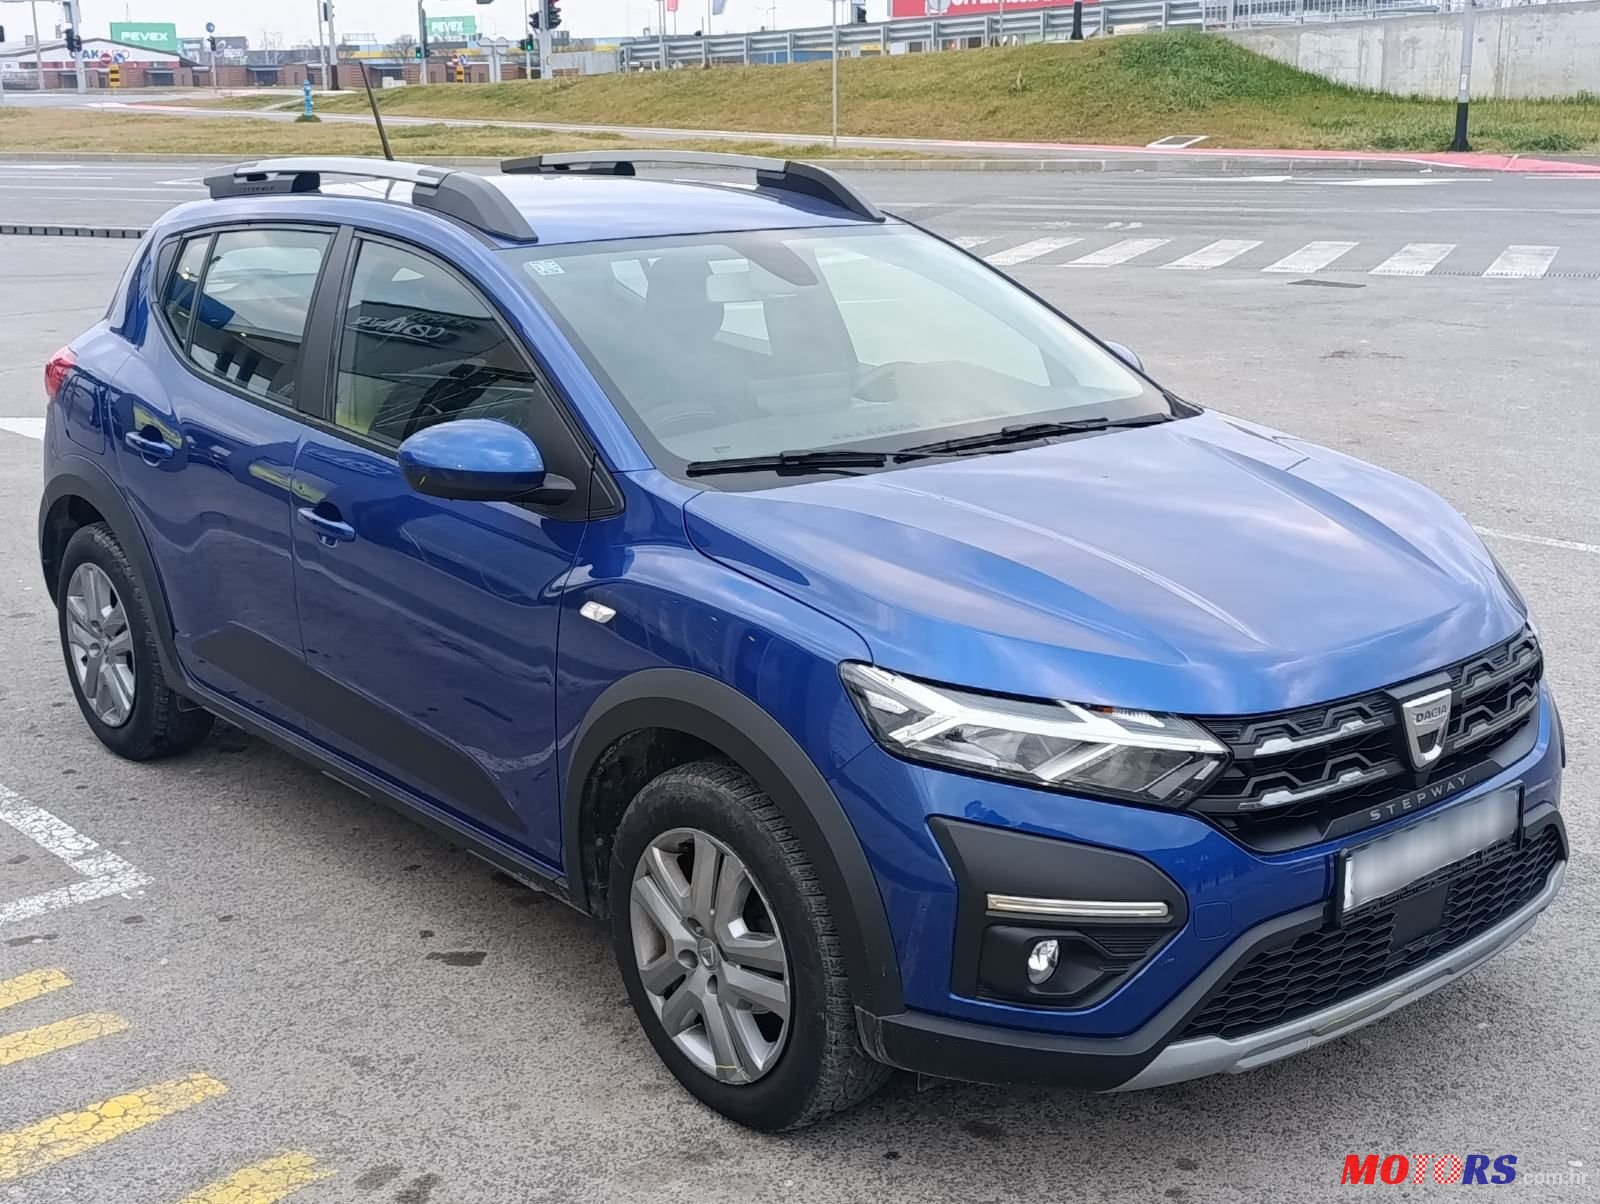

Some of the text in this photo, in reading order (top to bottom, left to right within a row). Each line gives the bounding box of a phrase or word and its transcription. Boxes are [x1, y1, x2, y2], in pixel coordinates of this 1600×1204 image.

[432, 20, 464, 33] PEVEX
[121, 31, 169, 42] PEVEX
[69, 49, 99, 60] CAK
[1415, 704, 1448, 723] DACIA
[1369, 774, 1468, 821] STEPWAY
